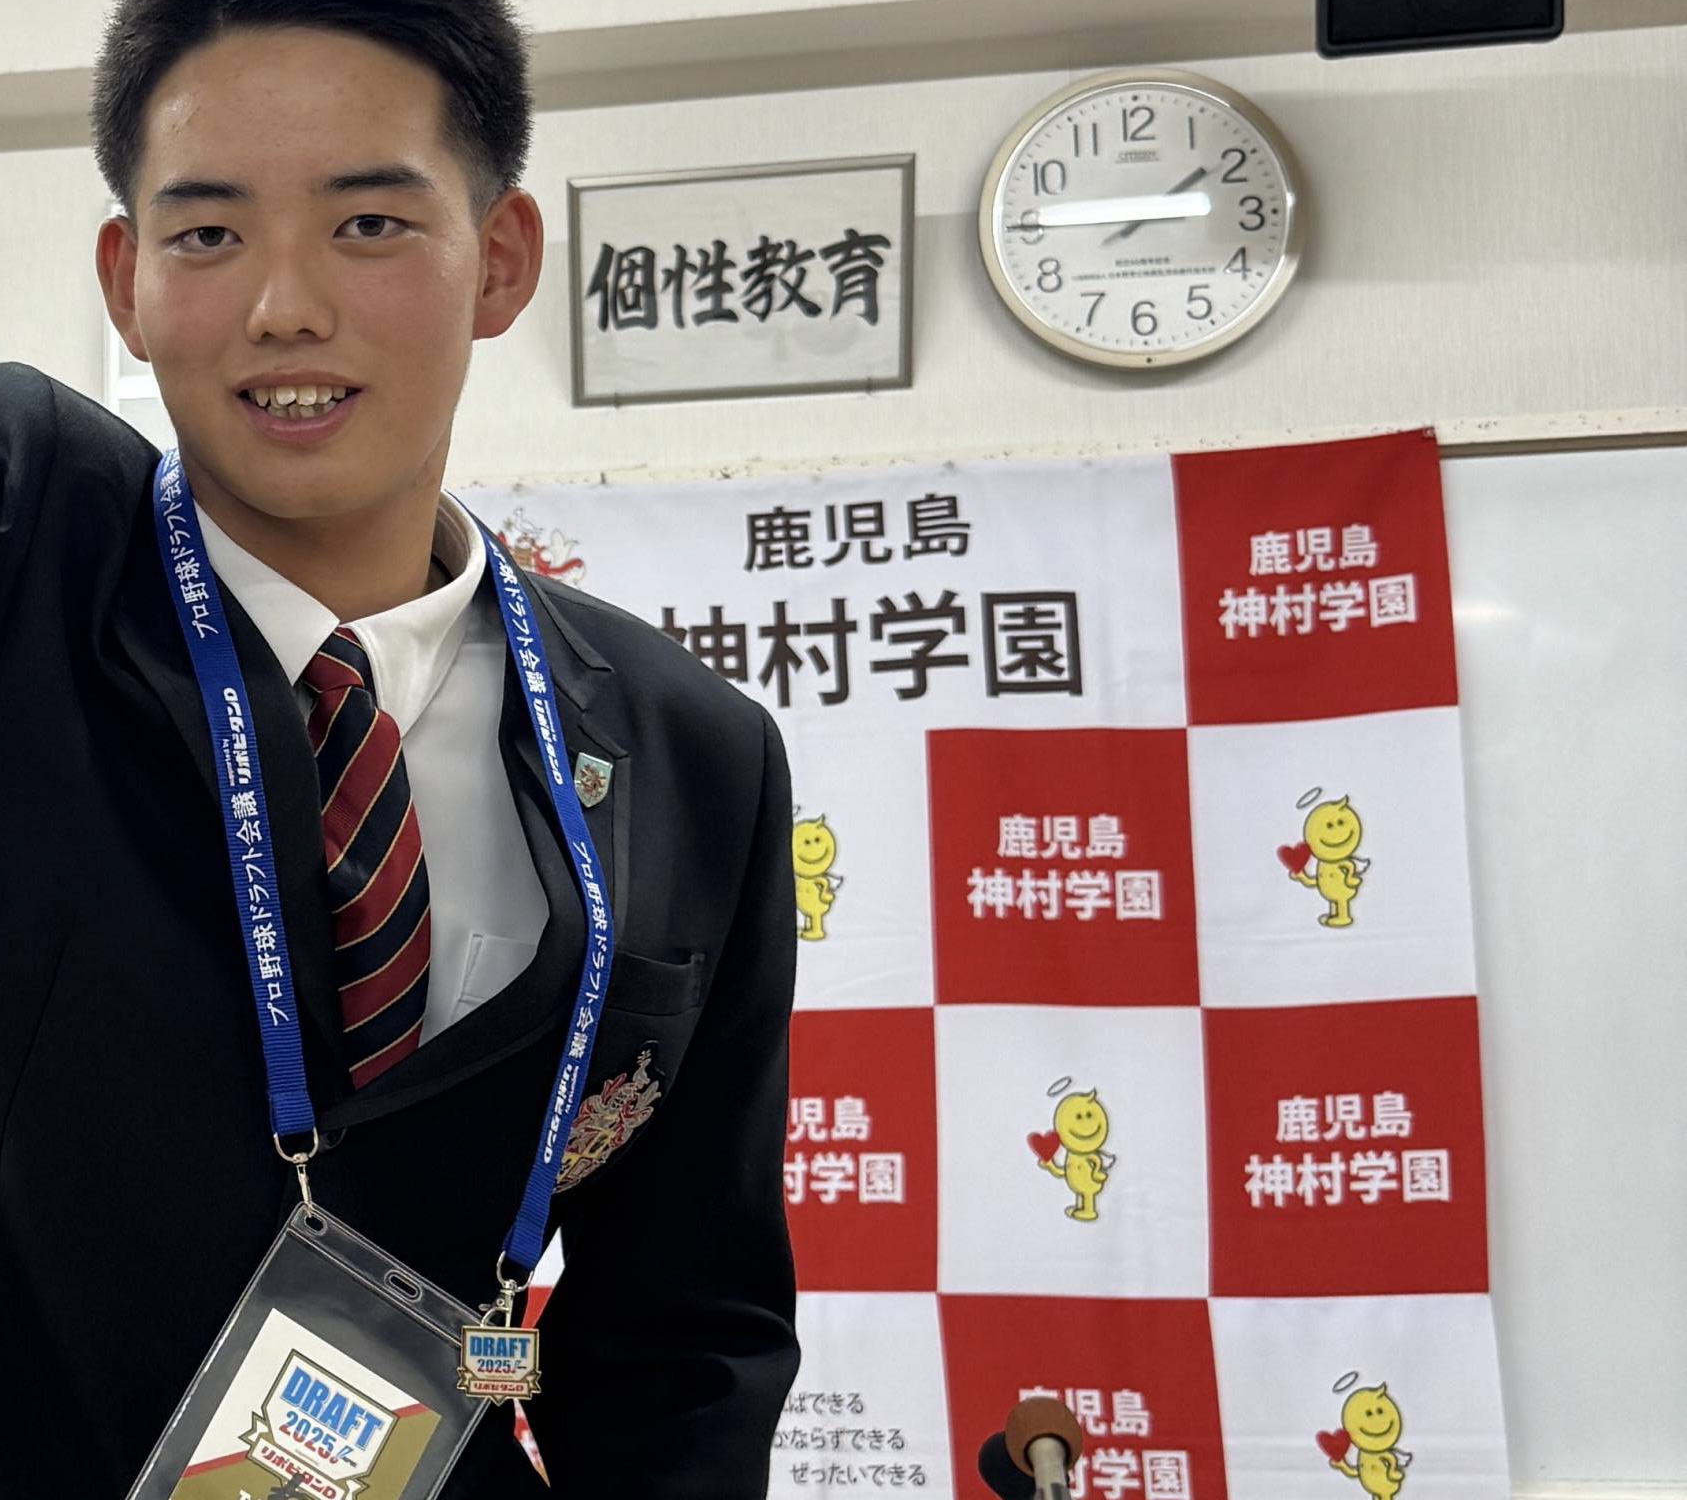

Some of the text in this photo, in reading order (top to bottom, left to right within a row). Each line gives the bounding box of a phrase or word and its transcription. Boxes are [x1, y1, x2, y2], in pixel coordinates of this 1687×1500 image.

[1074, 122, 1098, 157] 11
[1122, 106, 1156, 141] 12
[1033, 160, 1066, 195] 10
[1221, 149, 1247, 183] 2
[1239, 196, 1265, 231] 3
[586, 228, 892, 332] 個性教育
[1037, 258, 1062, 293] 8
[1224, 247, 1251, 280] 4
[1081, 293, 1105, 326] 7
[1131, 301, 1157, 336] 6
[1186, 285, 1212, 320] 5
[744, 493, 970, 572] 鹿児島
[1249, 523, 1378, 575] 鹿児島
[1218, 574, 1418, 639] 神村学園
[223, 687, 252, 784] リポビタンD
[997, 814, 1126, 860] 鹿児島
[231, 790, 289, 1026] プロ野球ドラフト会議
[967, 867, 1162, 922] 神村学園
[573, 841, 609, 1059] プロ野球ドラフト会議
[1276, 1091, 1412, 1143] 鹿児島
[1244, 1149, 1451, 1209] 神村学園
[470, 1336, 531, 1359] DRAFT
[477, 1359, 511, 1373] 2025
[279, 1366, 385, 1452] DRAFT
[1018, 1385, 1150, 1437] 児島
[792, 1463, 927, 1487] ぜったいできる
